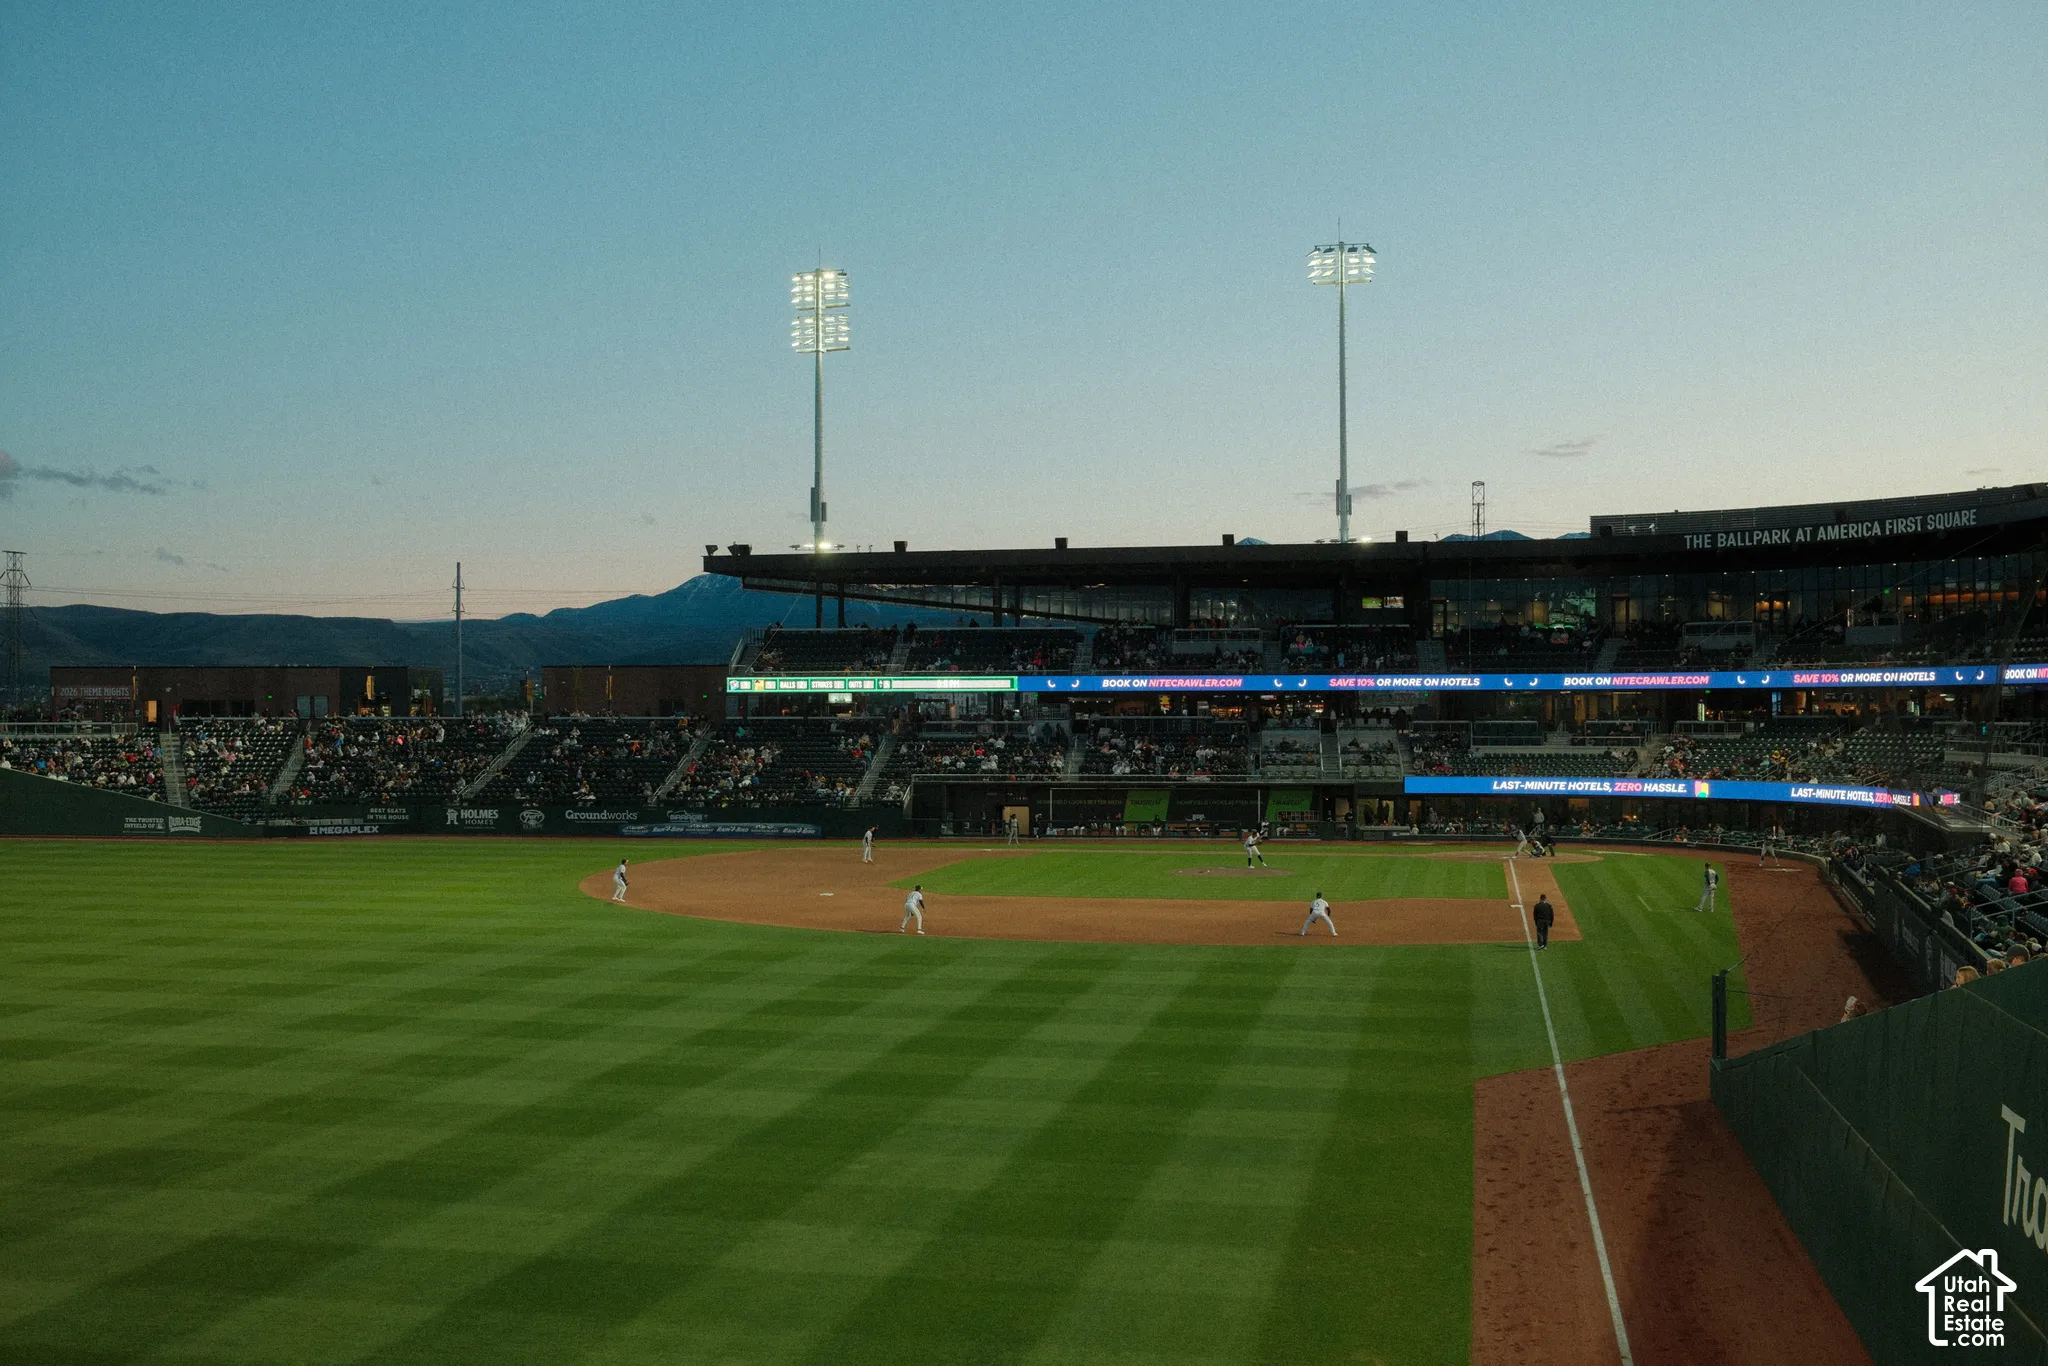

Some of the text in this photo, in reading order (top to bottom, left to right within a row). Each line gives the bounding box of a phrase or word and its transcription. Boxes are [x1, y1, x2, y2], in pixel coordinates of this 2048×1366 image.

[1684, 509, 1977, 549] THE BALLPARK AT AMERICA FIRST SQUARE
[1794, 672, 1935, 683] SAVE 10% OR MORE ON HOTELS
[2004, 669, 2025, 679] BOOK
[2026, 668, 2037, 678] ON
[1102, 680, 1131, 688] BOOK
[1149, 678, 1242, 687] NITECRAWLER.COM
[1330, 678, 1480, 687] SAVE 10% OR MORE ON HOTELS
[1564, 676, 1709, 686] BOOK ON NITECRAWLER.COM
[60, 687, 129, 696] 2026 THEME NIGHTS
[1493, 781, 1687, 793] LAST-MINUTE HOTELS, ZERO HASSLE.
[1791, 788, 1846, 800] LAST-MINUTE
[1847, 790, 1874, 804] HOTELS,
[1875, 792, 1892, 803] ZERO
[461, 809, 499, 819] HOLMES
[565, 810, 638, 820] Groundworks
[319, 826, 380, 834] MEGAPLEX
